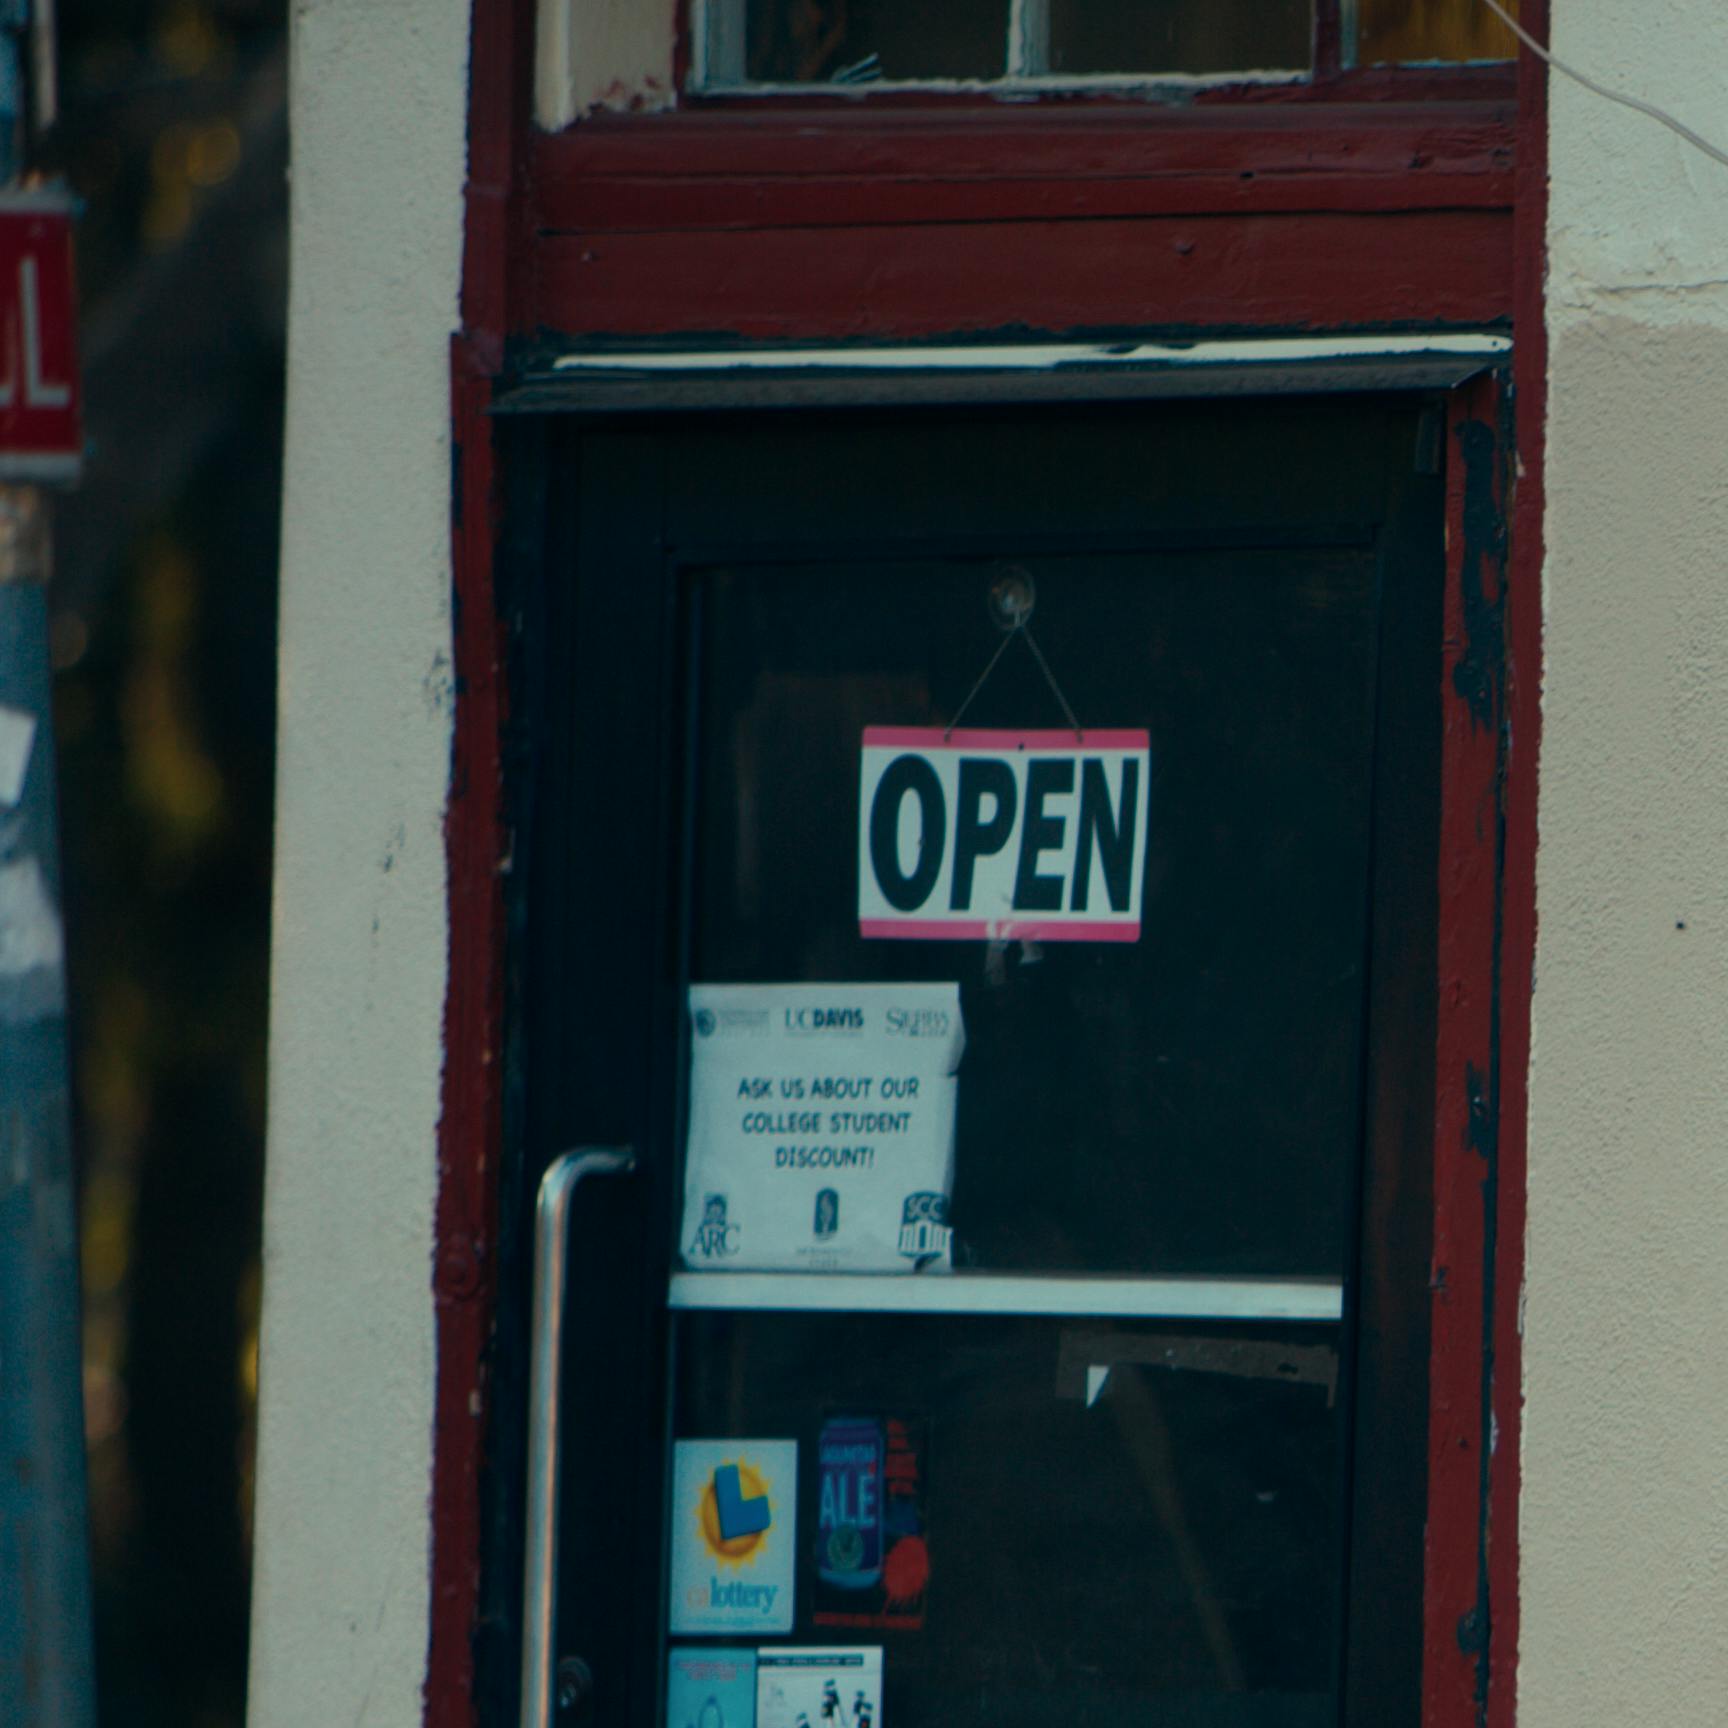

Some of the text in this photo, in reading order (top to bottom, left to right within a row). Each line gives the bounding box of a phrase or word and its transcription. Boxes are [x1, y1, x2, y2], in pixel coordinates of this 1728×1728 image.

[869, 753, 1140, 913] OPEN
[737, 1077, 920, 1099] ASK US ABOUT OUR
[741, 1112, 912, 1135] COLLEGE STUDENT
[774, 1146, 876, 1169] DISCOUNT!
[689, 1222, 741, 1258] ARC
[819, 1473, 877, 1529] ALE
